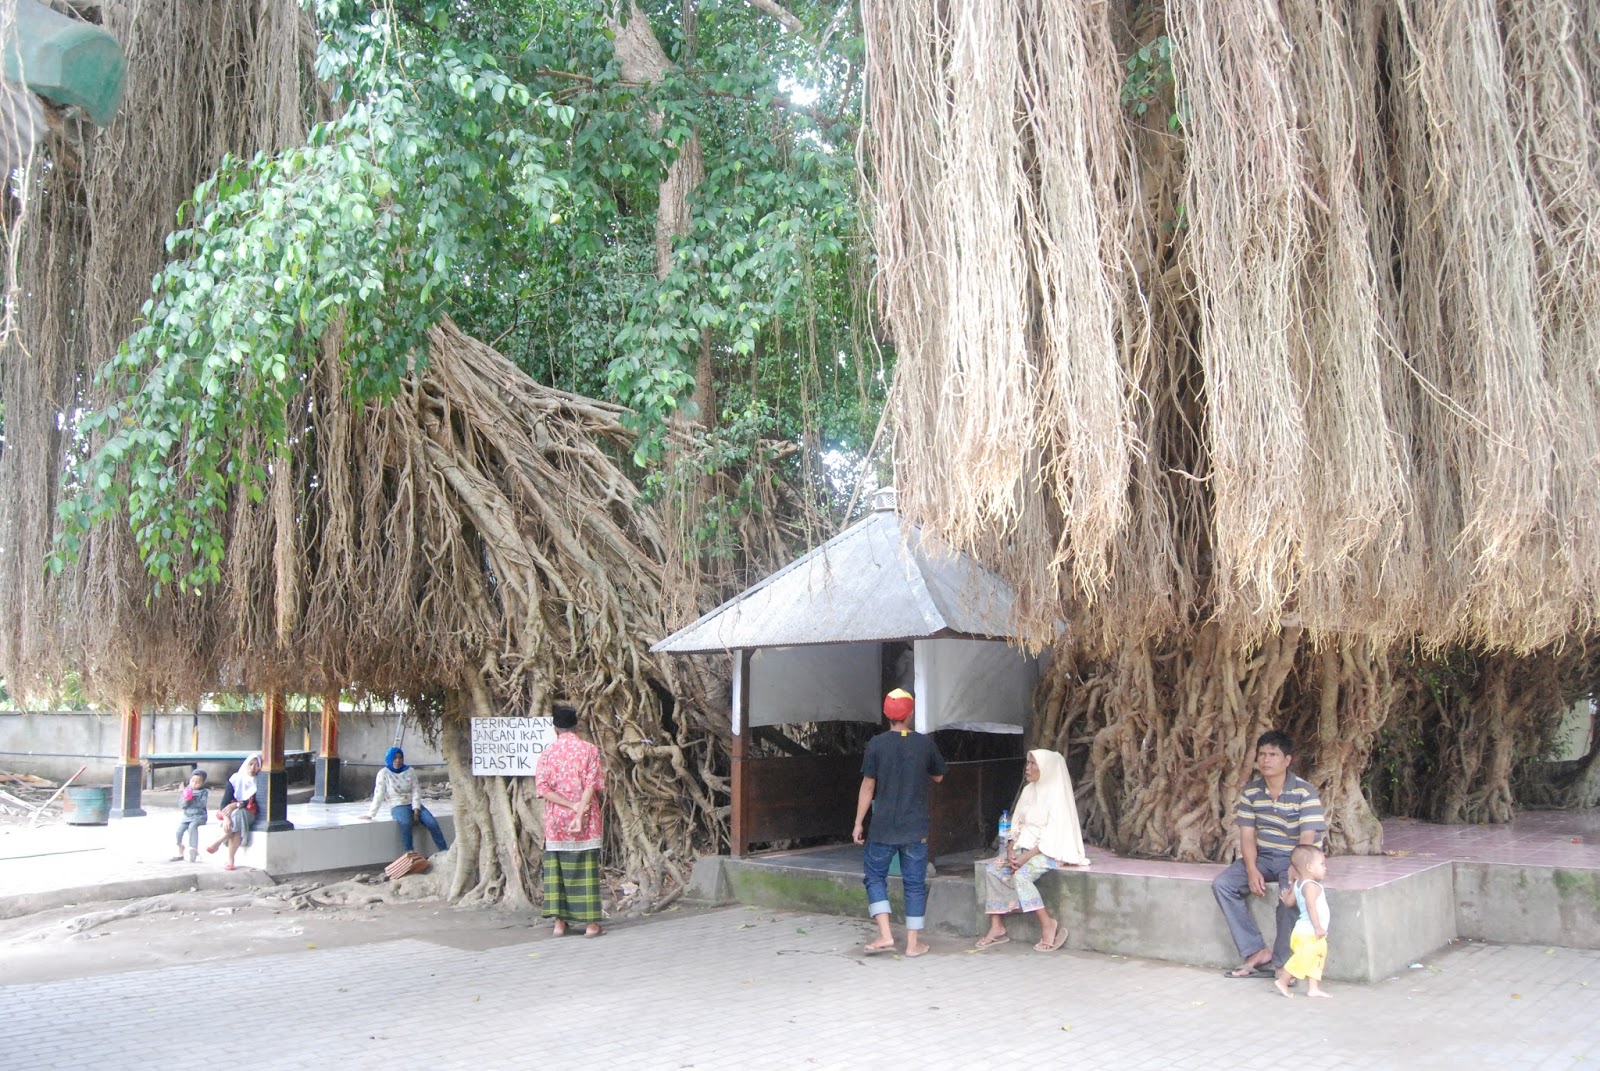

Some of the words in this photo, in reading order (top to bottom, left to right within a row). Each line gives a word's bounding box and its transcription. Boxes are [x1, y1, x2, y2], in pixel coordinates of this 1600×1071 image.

[474, 718, 553, 729] PERINGATAN
[474, 730, 515, 741] JANGAN
[520, 730, 545, 740] IKAT
[474, 743, 528, 754] BERINGIN
[474, 756, 531, 769] PLASTIK
